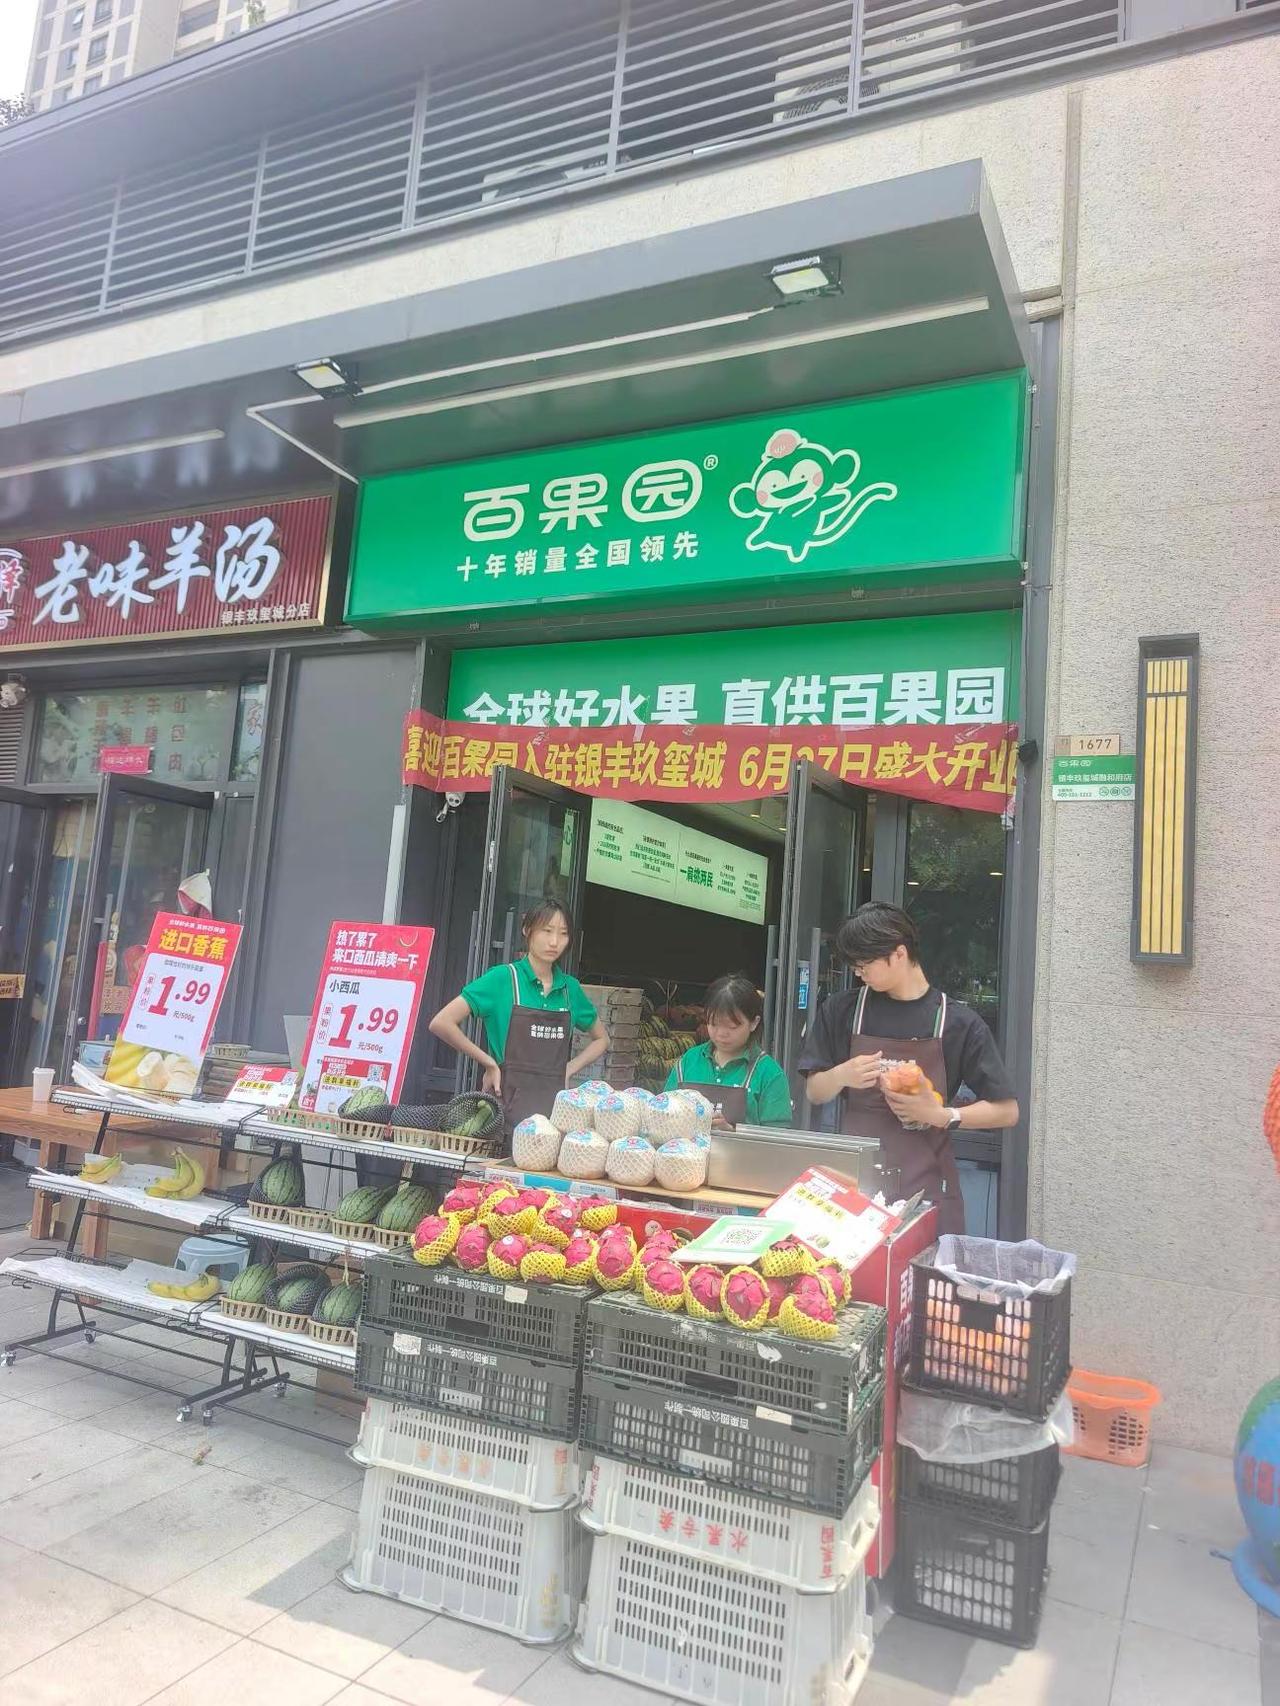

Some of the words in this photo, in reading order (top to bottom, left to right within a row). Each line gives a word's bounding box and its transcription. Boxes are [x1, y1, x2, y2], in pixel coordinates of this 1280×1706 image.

[462, 458, 703, 543] 百果园
[32, 516, 282, 626] 老味羊汤
[456, 531, 699, 582] 十年销量全国领先
[463, 683, 698, 727] 全球好水果
[722, 667, 1006, 729] 直供百果园
[1058, 760, 1092, 768] 百果园
[1079, 738, 1112, 750] 1677
[158, 927, 229, 961] 进口香蕉
[147, 976, 211, 1016] 1.99
[329, 979, 361, 995] 小西瓜
[328, 1004, 399, 1049] 1.99
[358, 1041, 383, 1054] 元/500g
